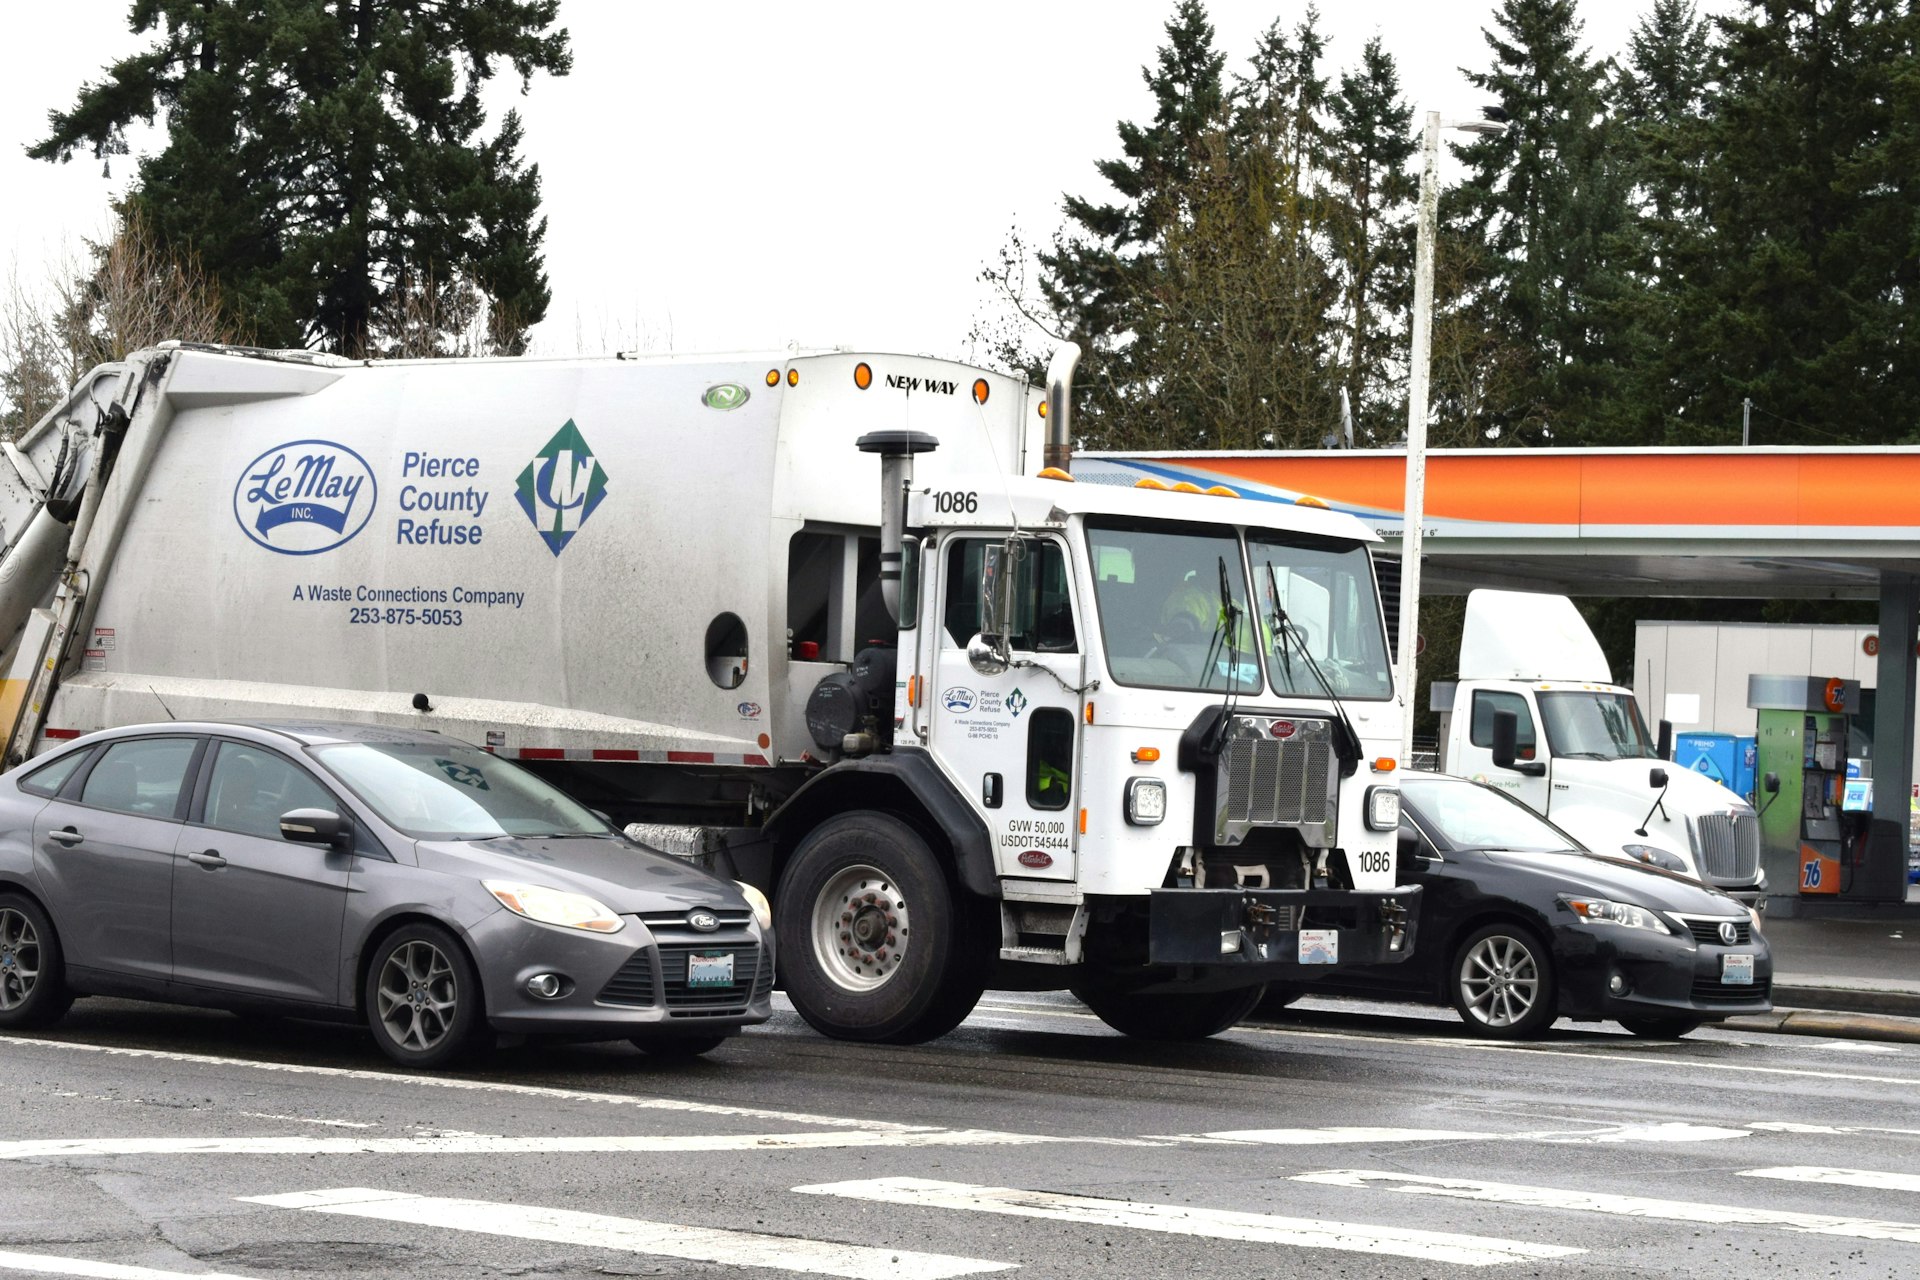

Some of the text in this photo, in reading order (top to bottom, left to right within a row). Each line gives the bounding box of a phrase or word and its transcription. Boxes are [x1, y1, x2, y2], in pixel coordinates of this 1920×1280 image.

[885, 374, 959, 395] NEW WAY
[402, 451, 480, 478] Pierce
[247, 453, 364, 504] LeMay
[399, 485, 489, 518] County
[932, 491, 978, 514] 1086
[291, 506, 314, 520] INC.
[396, 518, 483, 545] Refuse
[1375, 528, 1404, 536] Clearan
[292, 584, 525, 608] A Waste Connections Company
[349, 607, 463, 627] 253-875-5053
[945, 689, 974, 702] LeMay
[980, 690, 1000, 698] Pierce
[1831, 686, 1846, 704] 76
[979, 698, 1002, 707] County
[979, 705, 1001, 713] Refuse
[993, 720, 1011, 728] Company
[1693, 740, 1715, 748] PRIMO
[1847, 792, 1864, 801] ICE
[1008, 819, 1065, 835] GVW 50,000
[1001, 834, 1069, 849] USDOT 545444
[1358, 851, 1390, 873] 1086
[1803, 858, 1821, 888] 76
[699, 916, 714, 925] Ford
